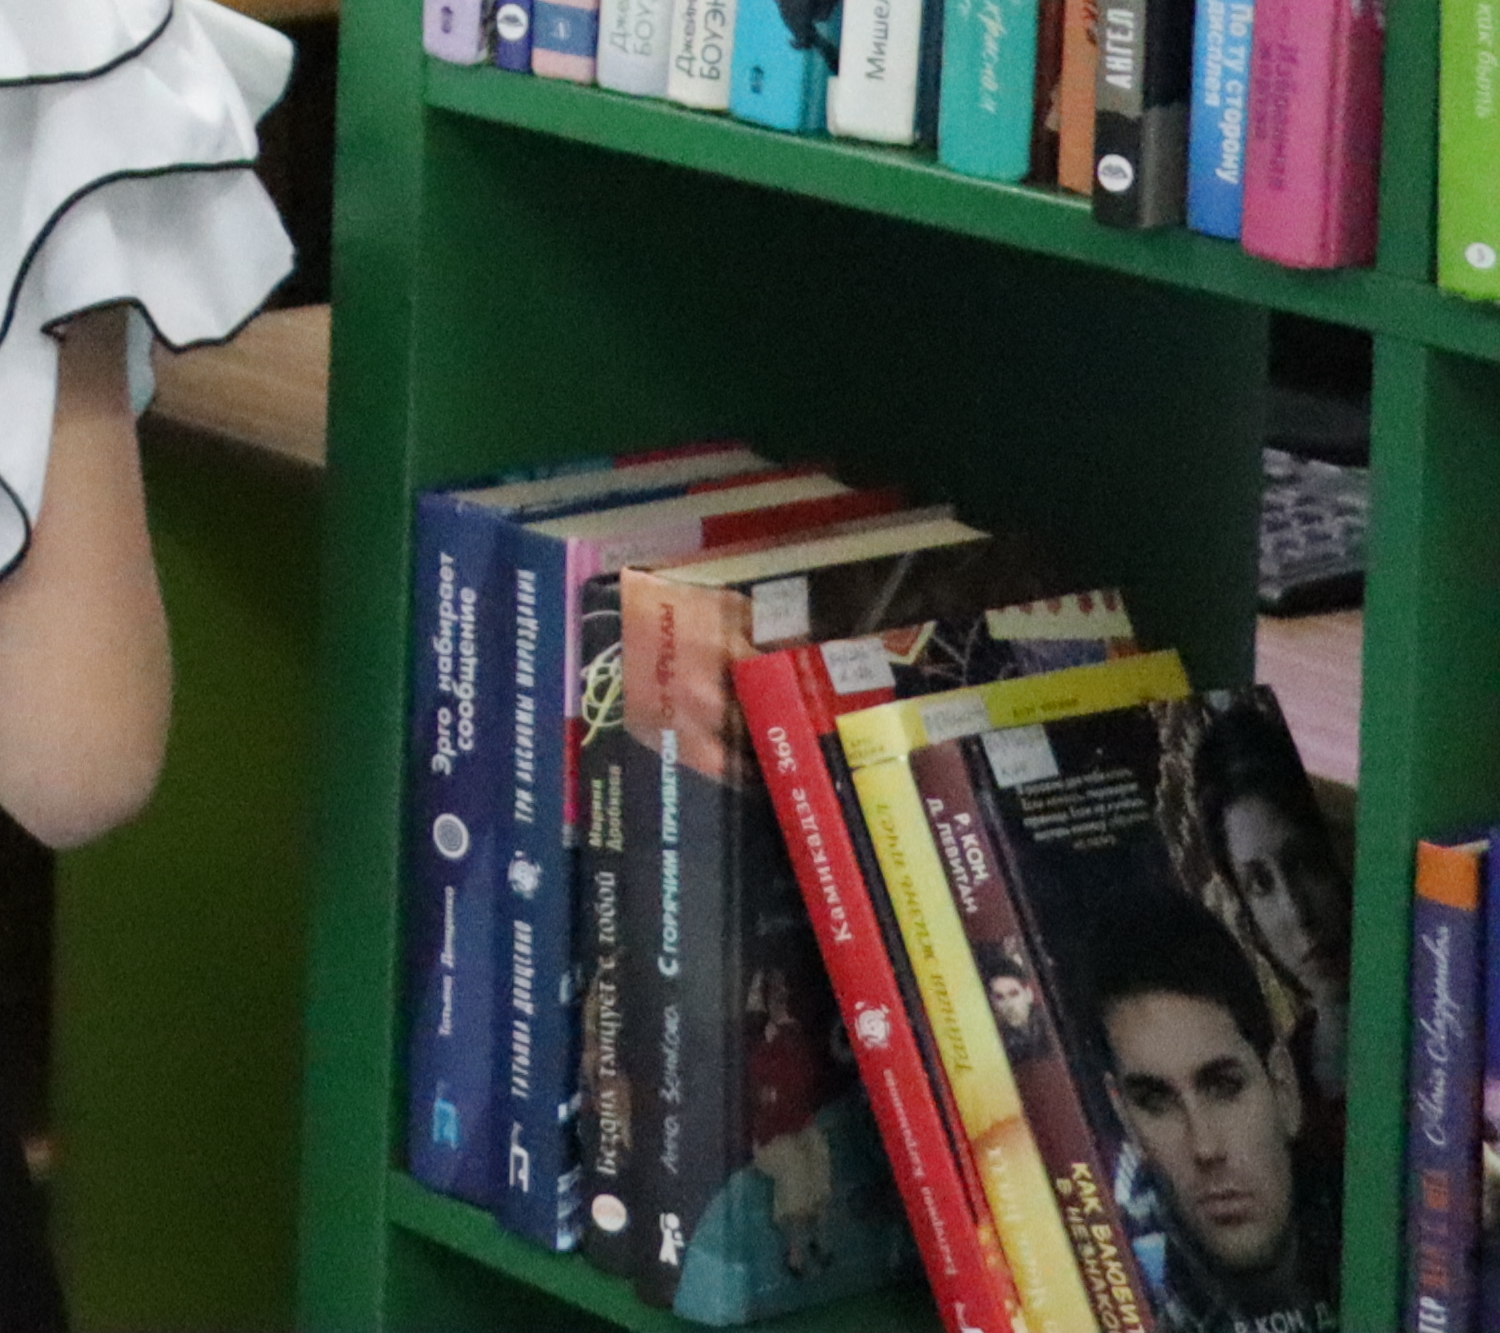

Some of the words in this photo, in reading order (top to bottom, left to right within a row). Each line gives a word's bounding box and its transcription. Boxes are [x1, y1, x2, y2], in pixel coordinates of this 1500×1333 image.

[977, 0, 1007, 114] красном
[1104, 6, 1131, 89] АНГЕЛ
[1221, 43, 1247, 73] ту
[1227, 3, 1253, 37] По
[1479, 4, 1495, 46] как
[1216, 79, 1244, 185] сторону
[434, 551, 457, 694] набирает
[516, 568, 539, 688] МИРОЗДАНИЯ
[455, 588, 477, 751] сообщение
[432, 708, 456, 776] Эрго
[516, 694, 534, 782] АКСИОМЫ
[766, 725, 798, 774] 360
[515, 788, 533, 824] ТРИ
[658, 730, 678, 843] ПРИВЕТОМ
[594, 872, 616, 946] тобой
[659, 851, 679, 955] ГОРЯЧИМ
[789, 787, 853, 943] Камикадзе
[933, 821, 979, 914] ЛЕВИТАН
[898, 878, 942, 961] жизнь
[657, 959, 679, 977] С
[511, 1021, 531, 1099] ТАТЬЯНА
[594, 981, 625, 1077] танцует
[930, 971, 974, 1077] Тайная
[594, 1088, 622, 1176] Бездна
[1070, 1163, 1103, 1214] КАК
